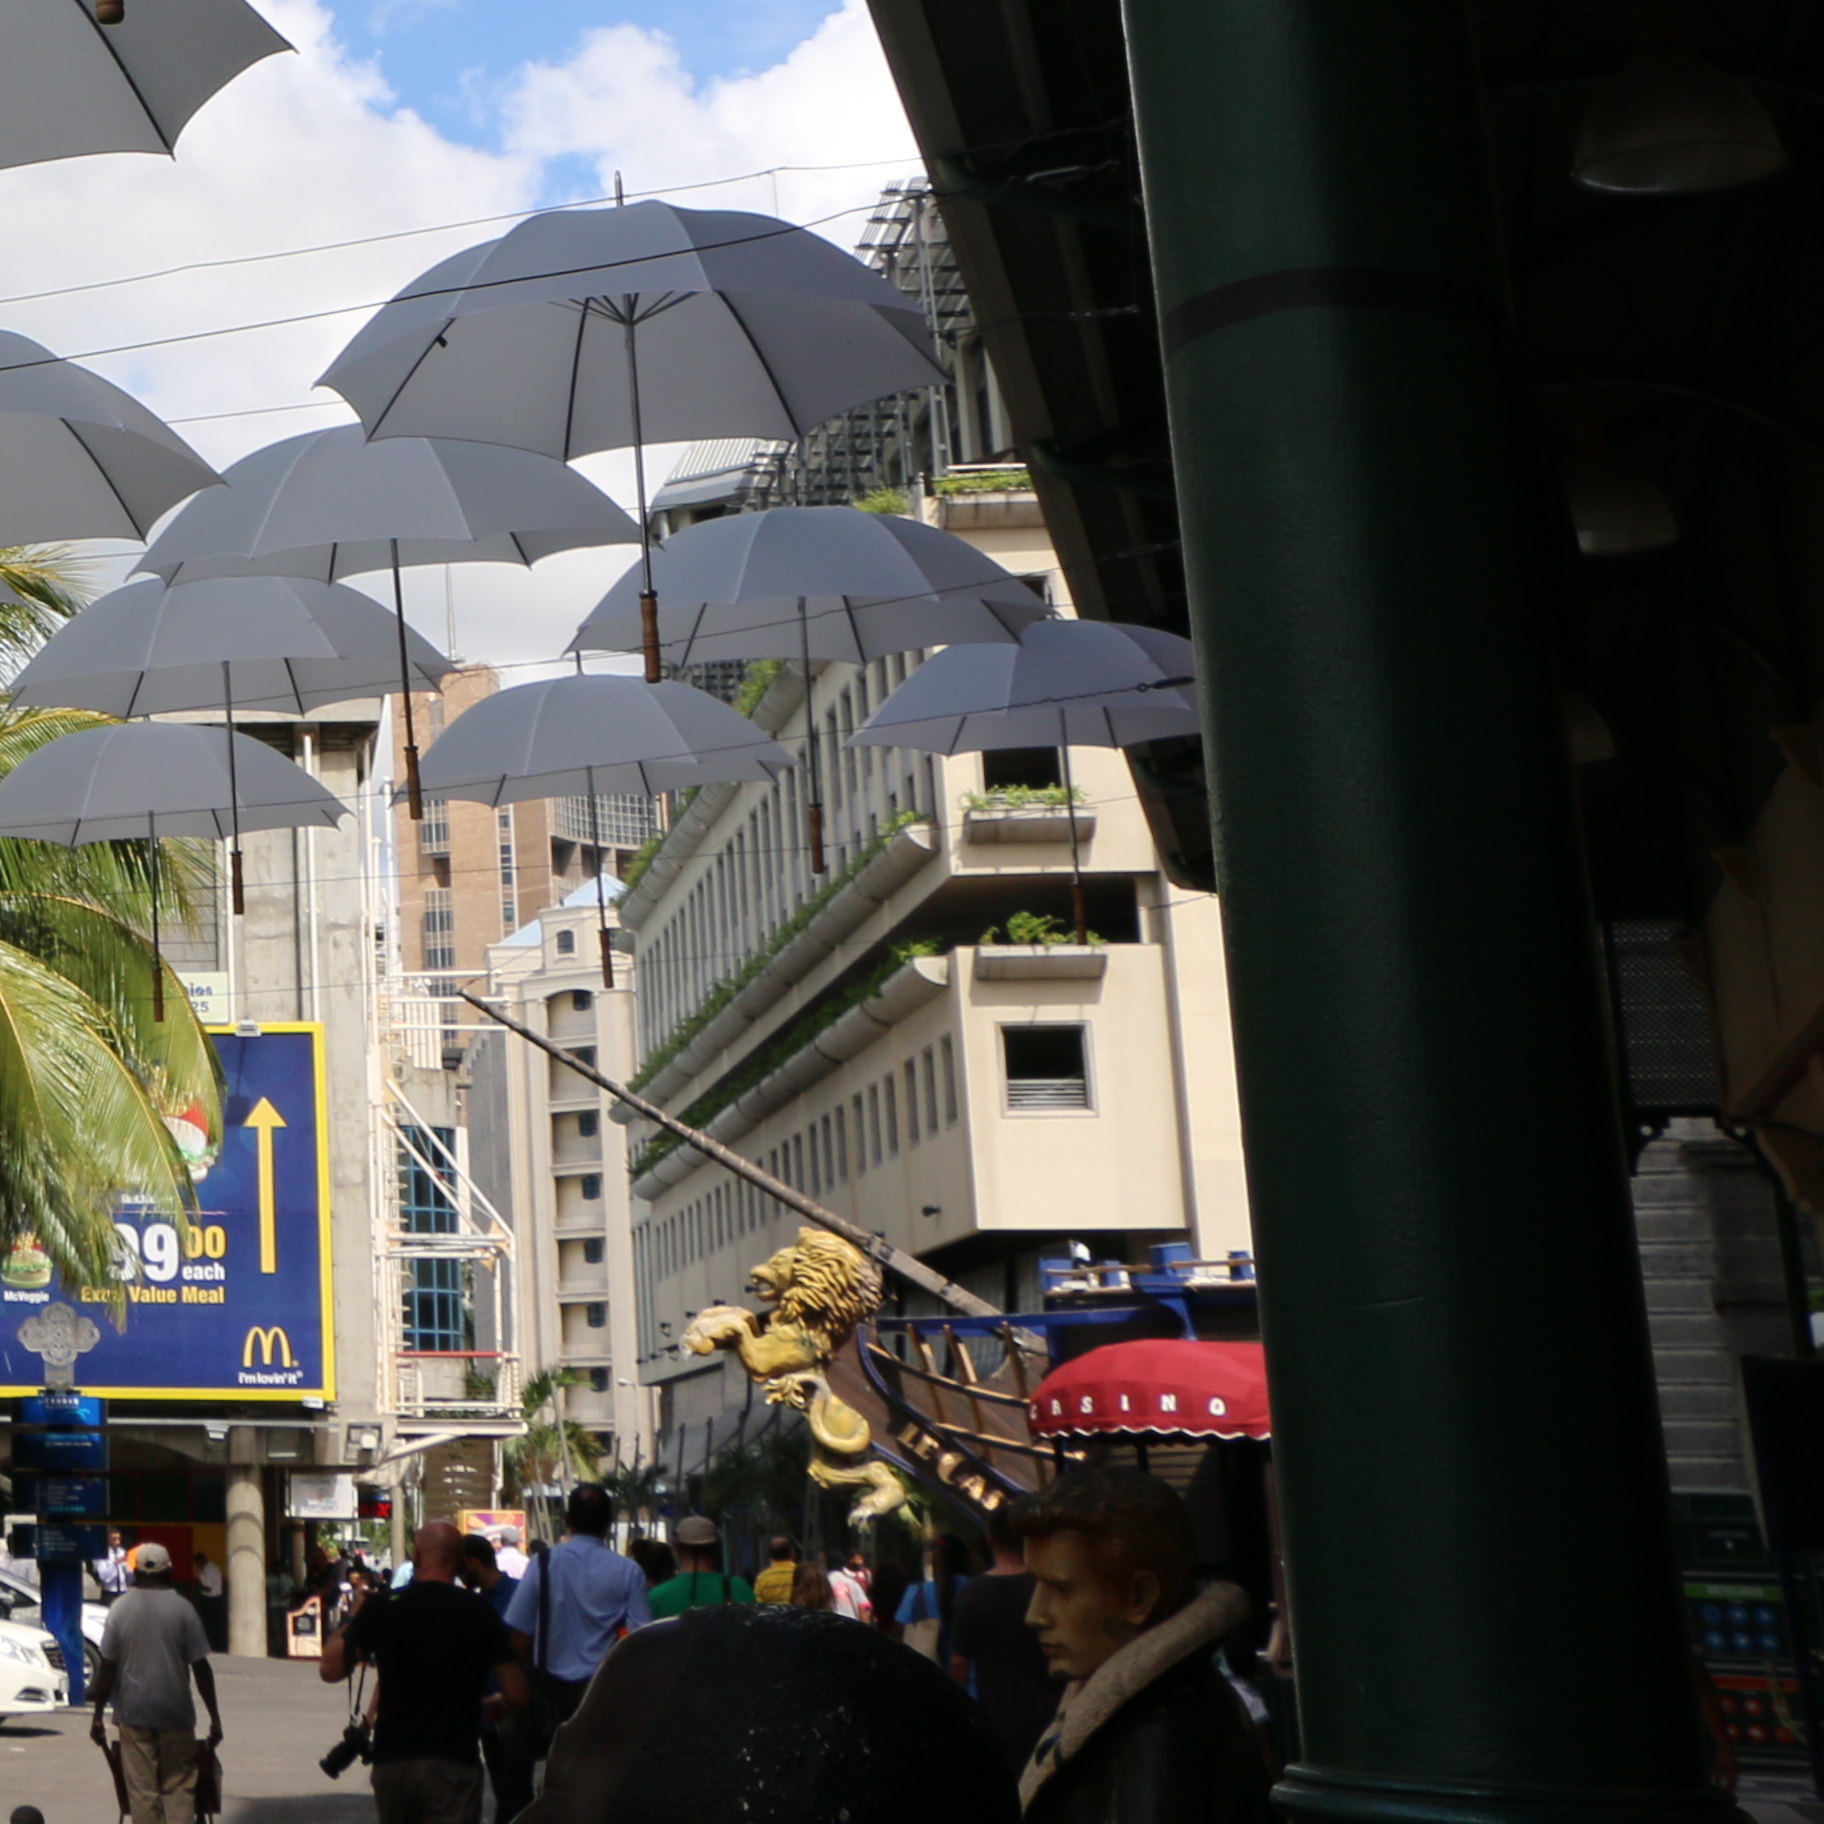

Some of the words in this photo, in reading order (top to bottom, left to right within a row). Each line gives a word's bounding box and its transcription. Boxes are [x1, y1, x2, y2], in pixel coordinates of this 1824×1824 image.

[182, 1263, 226, 1281] each
[3, 1290, 50, 1304] McVeggie
[128, 1286, 177, 1303] Value
[182, 1286, 225, 1303] Meal
[1029, 1393, 1227, 1421] CASINO
[896, 1422, 941, 1461] LE
